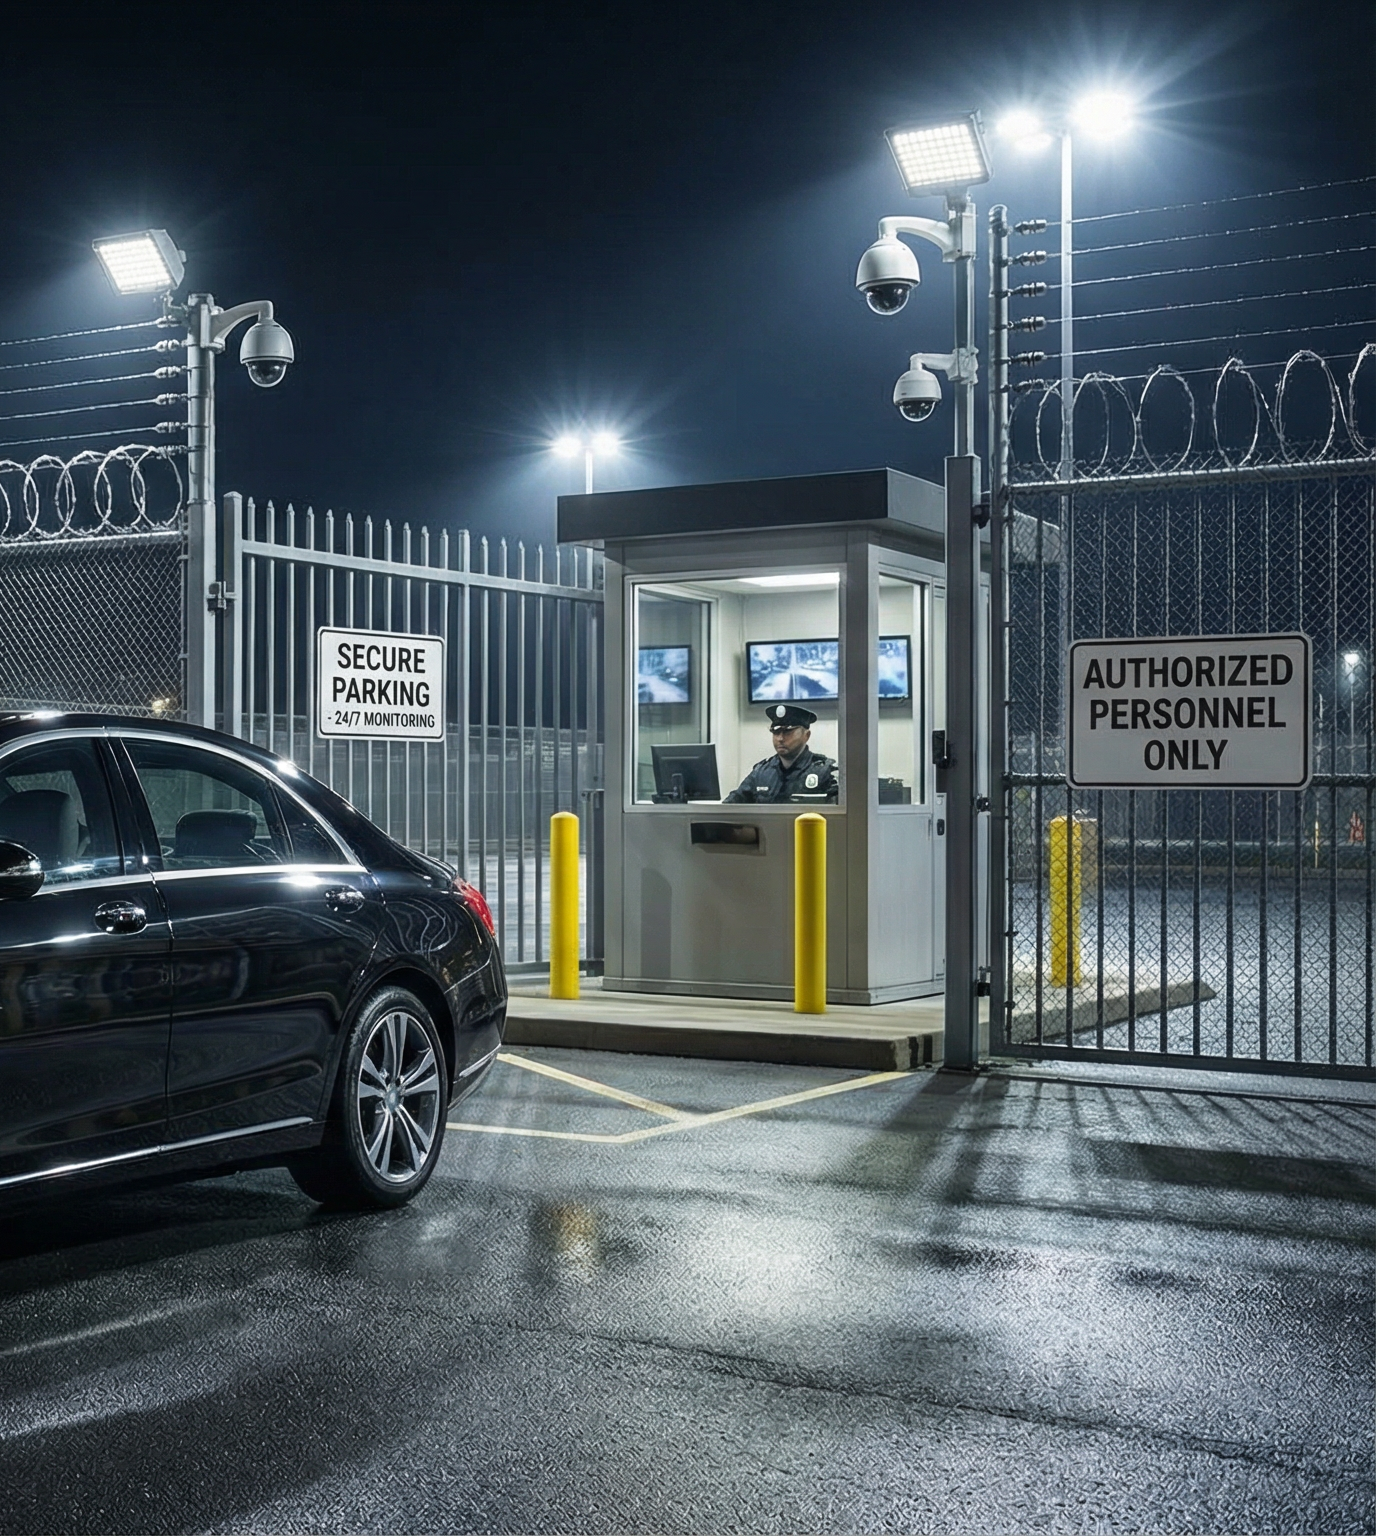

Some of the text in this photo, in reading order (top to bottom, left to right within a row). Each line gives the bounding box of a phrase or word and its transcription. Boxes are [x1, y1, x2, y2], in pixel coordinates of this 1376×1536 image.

[337, 642, 426, 674] SECURE
[1082, 654, 1293, 689] AUTHORIZED
[332, 676, 430, 707] PARKING
[334, 710, 361, 728] 24/7
[364, 711, 435, 728] MONITORING
[1090, 696, 1286, 730] PERSONNEL
[1144, 739, 1228, 771] ONLY
